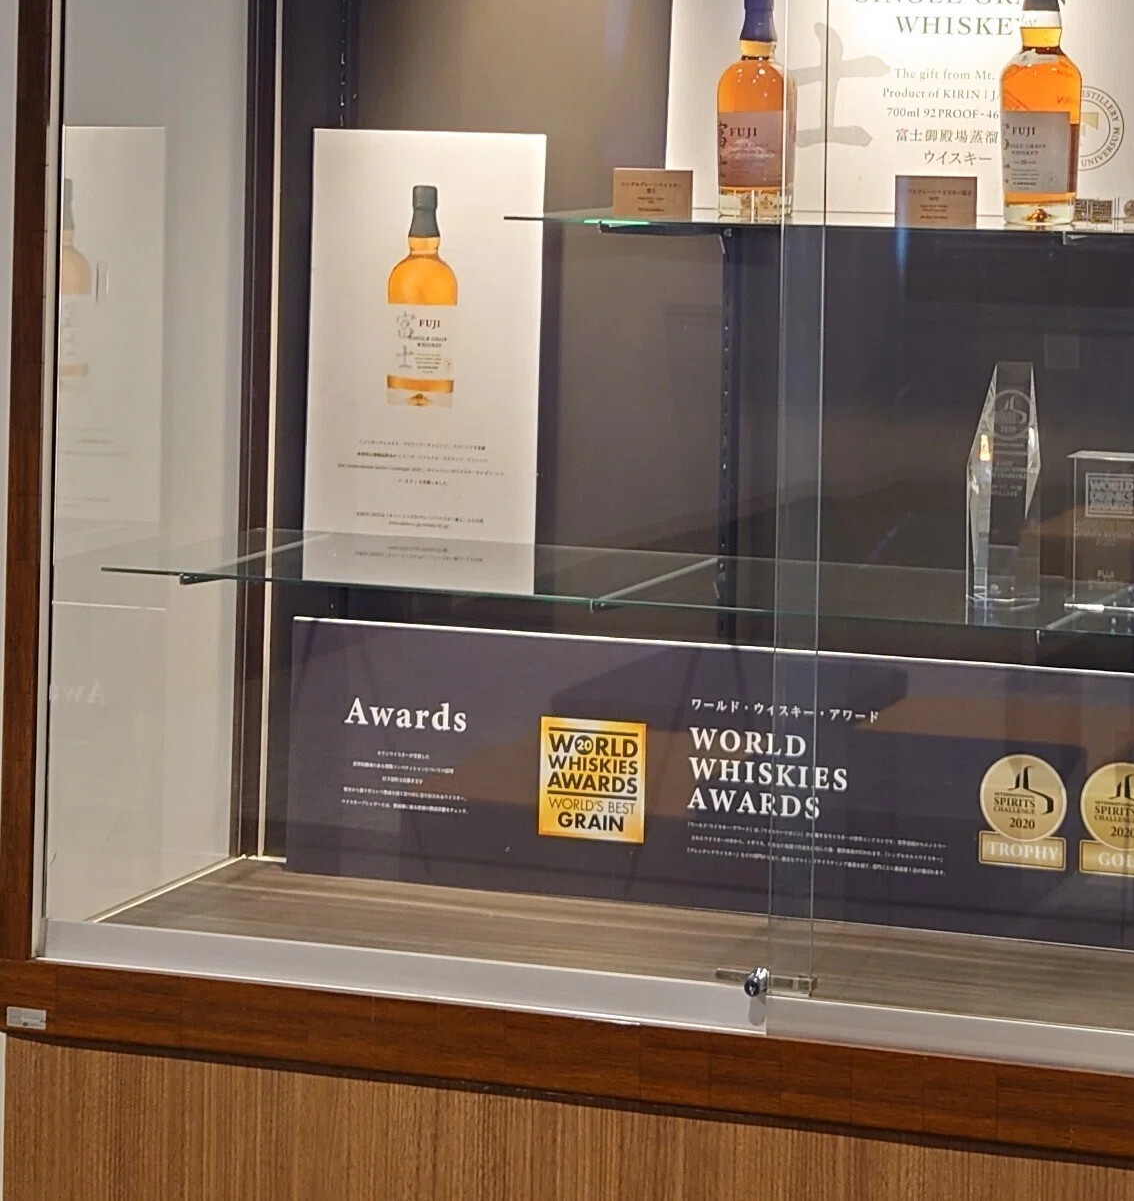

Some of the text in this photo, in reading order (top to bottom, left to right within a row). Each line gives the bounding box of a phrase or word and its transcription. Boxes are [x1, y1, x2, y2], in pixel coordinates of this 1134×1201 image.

[895, 68, 996, 82] The gift from Mt.
[883, 87, 925, 99] Product
[928, 88, 941, 99] of
[943, 89, 980, 99] KIRIN
[887, 107, 920, 118] 700ml
[1083, 90, 1120, 122] ISTILLERY
[730, 127, 758, 139] FUJI
[896, 128, 999, 145] 富士御殿場蒸溜
[1012, 126, 1036, 138] FUJI
[1081, 127, 1120, 167] UNIVERSUM
[924, 150, 993, 166] ウイスキー
[419, 319, 441, 330] FUJI
[1089, 479, 1134, 492] WORLD
[344, 697, 467, 732] Awards
[689, 726, 806, 758] WORLD
[548, 754, 638, 776] WHISKIES
[688, 756, 848, 792] WHISKIES
[547, 771, 638, 794] AWARDS
[548, 796, 636, 815] WORLD'S BEST
[687, 786, 820, 820] AWARDS
[994, 796, 1036, 809] SPIRITS
[557, 811, 624, 832] GRAIN
[1009, 816, 1036, 830] 2020
[987, 840, 1060, 862] TROPHY
